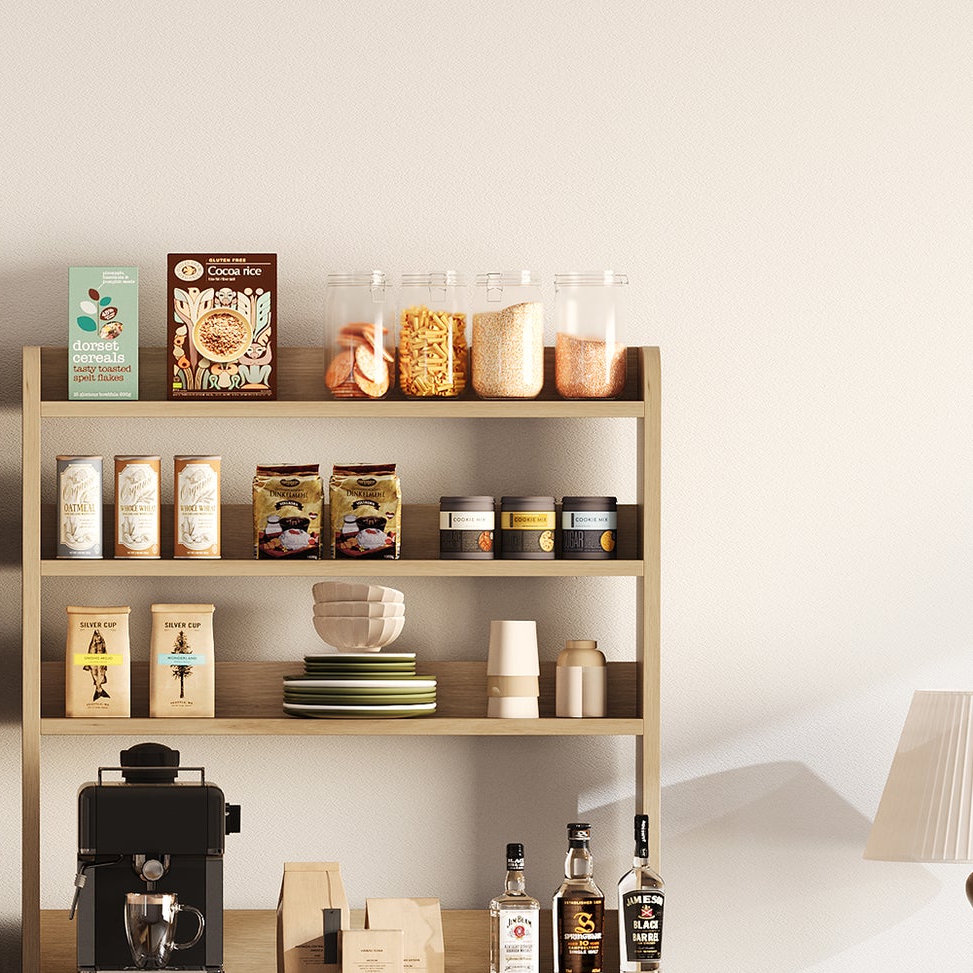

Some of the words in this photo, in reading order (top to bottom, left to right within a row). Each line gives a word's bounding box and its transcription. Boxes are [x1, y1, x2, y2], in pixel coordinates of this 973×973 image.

[207, 266, 241, 276] Cocoa
[242, 265, 262, 276] rice
[72, 340, 119, 351] dorset
[72, 352, 125, 363] cereals
[73, 366, 96, 374] tasty
[73, 374, 96, 383] spelt
[97, 374, 124, 382] flakes
[63, 503, 96, 513] OATMEAL
[633, 920, 659, 930] BLACK
[632, 932, 660, 942] BARREL
